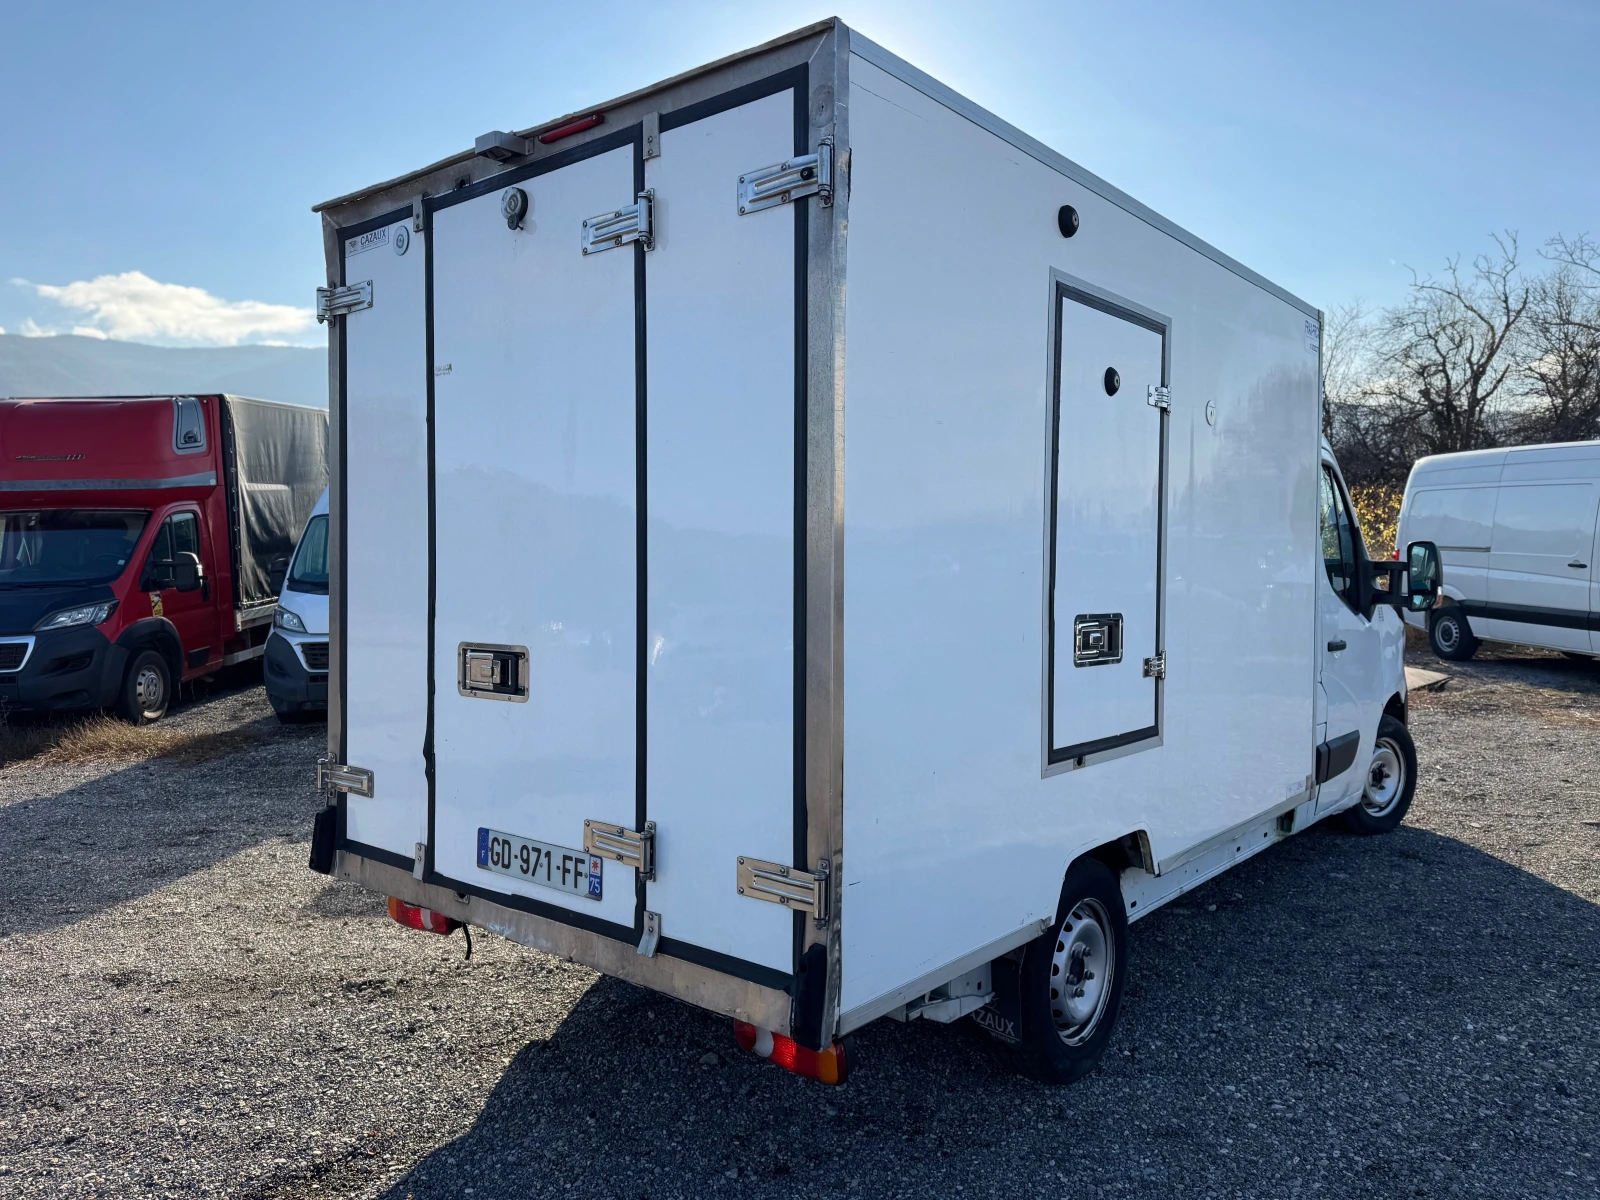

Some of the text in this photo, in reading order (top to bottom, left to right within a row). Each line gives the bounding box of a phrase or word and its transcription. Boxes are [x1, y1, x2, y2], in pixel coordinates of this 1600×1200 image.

[360, 229, 387, 246] CAZAUX
[481, 850, 486, 858] F
[491, 837, 586, 888] GD-971-FF
[589, 877, 600, 893] 75
